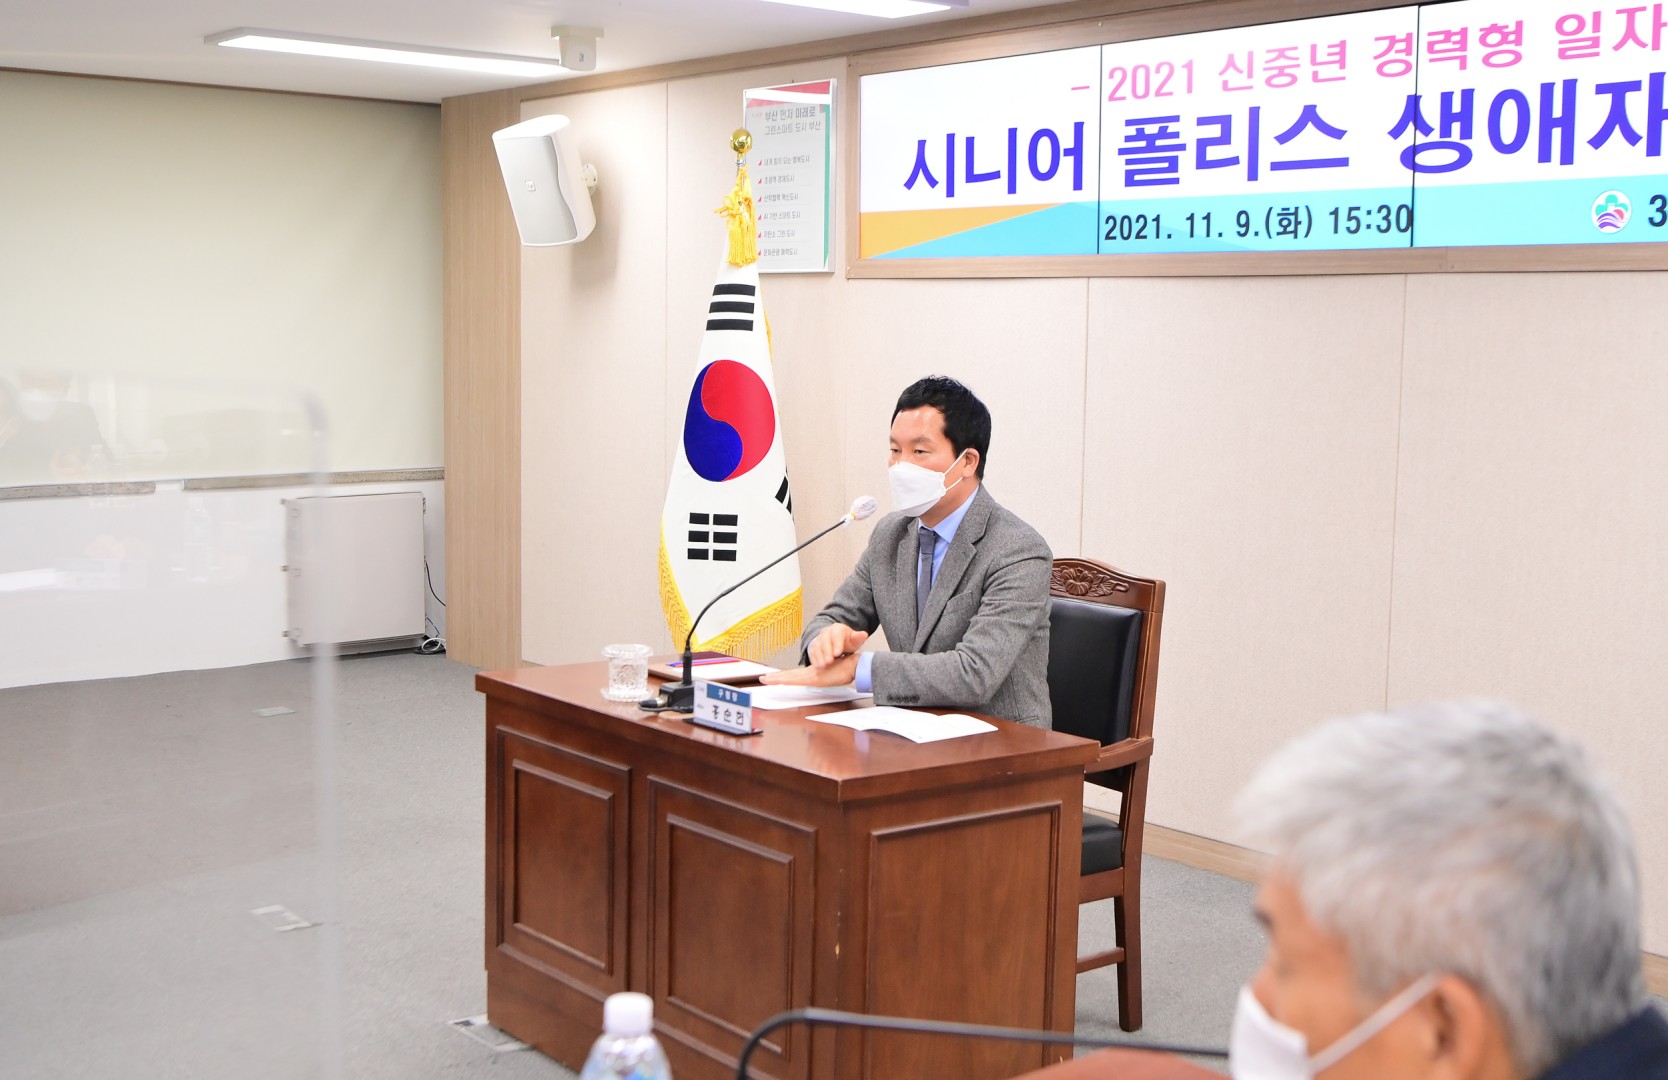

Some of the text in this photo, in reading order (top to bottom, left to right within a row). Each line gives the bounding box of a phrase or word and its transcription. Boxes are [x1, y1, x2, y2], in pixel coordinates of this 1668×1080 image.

[1107, 61, 1194, 103] 2021
[1218, 39, 1347, 92] 신중년
[1372, 19, 1524, 78] 경력형
[1554, 2, 1668, 61] 일자
[765, 111, 778, 122] 부산
[795, 106, 816, 119] 미래로
[795, 122, 807, 133] 도시
[808, 121, 821, 131] 부산
[903, 71, 1668, 198] 시니어 폴리스 생애자
[1104, 214, 1173, 241] 2021.
[1186, 212, 1225, 238] 11.
[1329, 204, 1413, 234] 15:30
